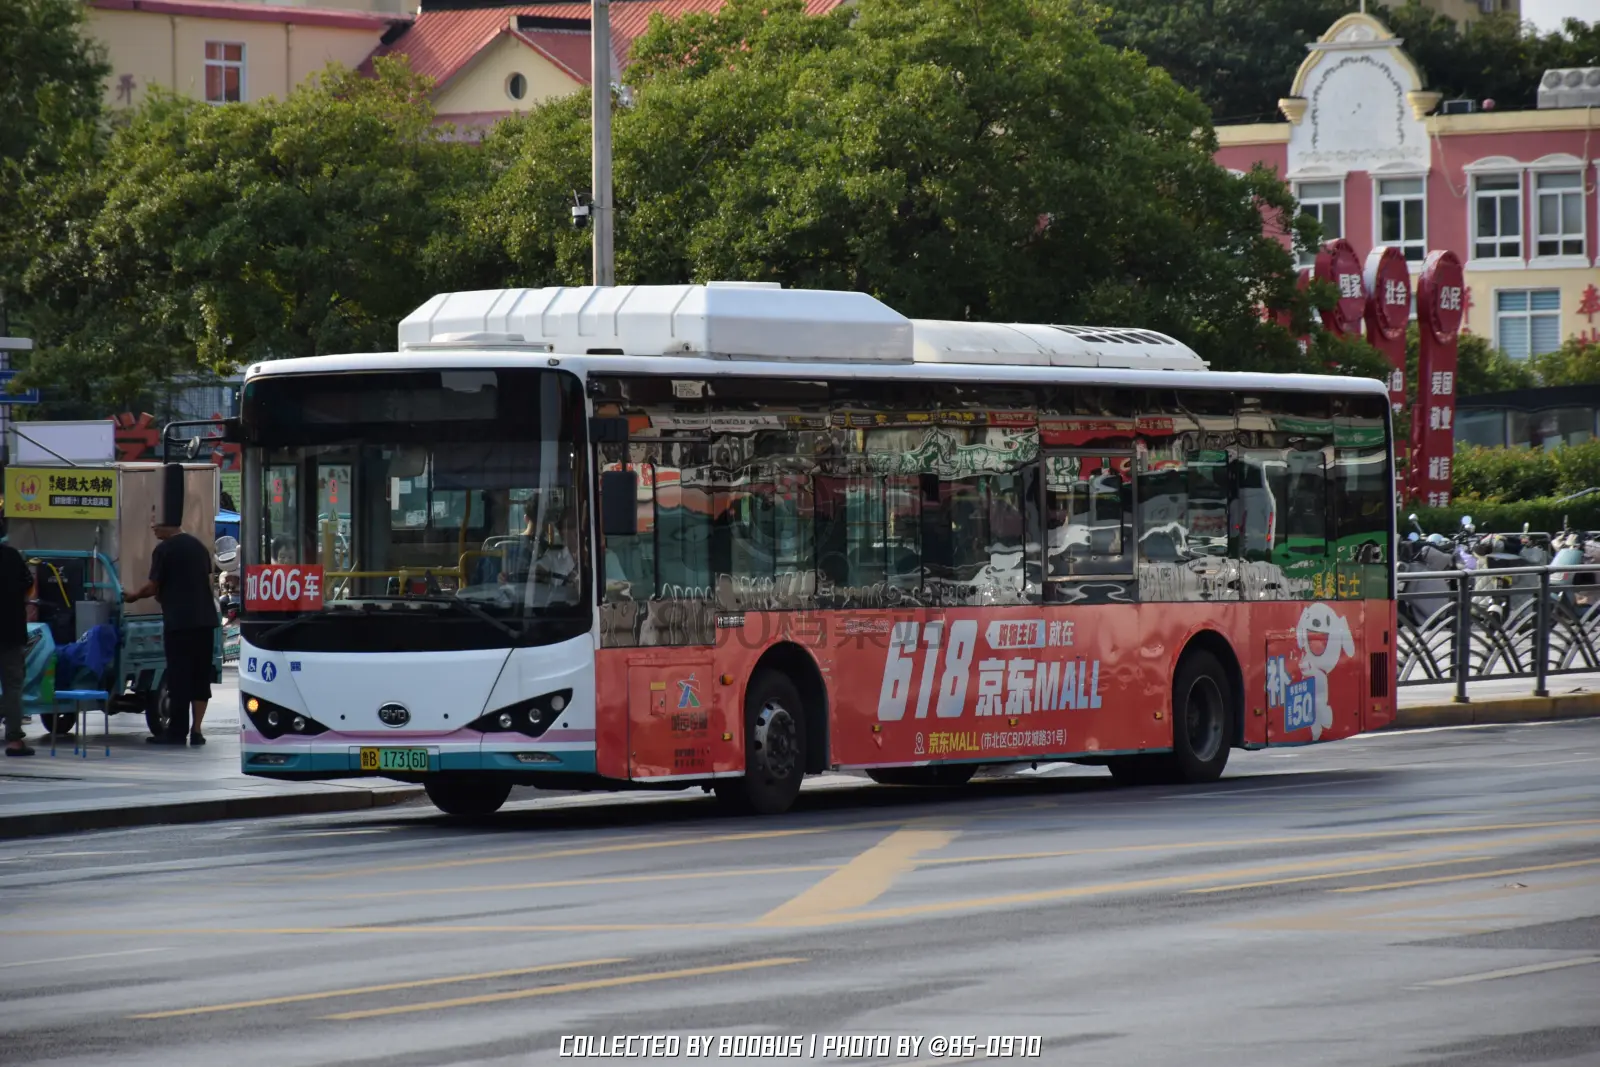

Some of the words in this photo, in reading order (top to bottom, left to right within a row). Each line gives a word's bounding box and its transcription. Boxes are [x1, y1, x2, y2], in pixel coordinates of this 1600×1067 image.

[1339, 273, 1362, 298] 国家
[1385, 279, 1406, 305] 社会
[1440, 286, 1461, 311] 公民
[1431, 371, 1453, 395] 爱国
[1430, 406, 1452, 430] 敬业
[1428, 456, 1450, 480] 诚信
[1048, 620, 1075, 647] 就在
[877, 619, 978, 721] 618
[975, 656, 1103, 717] 京东MALL
[381, 709, 406, 720] BYD
[928, 731, 980, 754] 京东MALL
